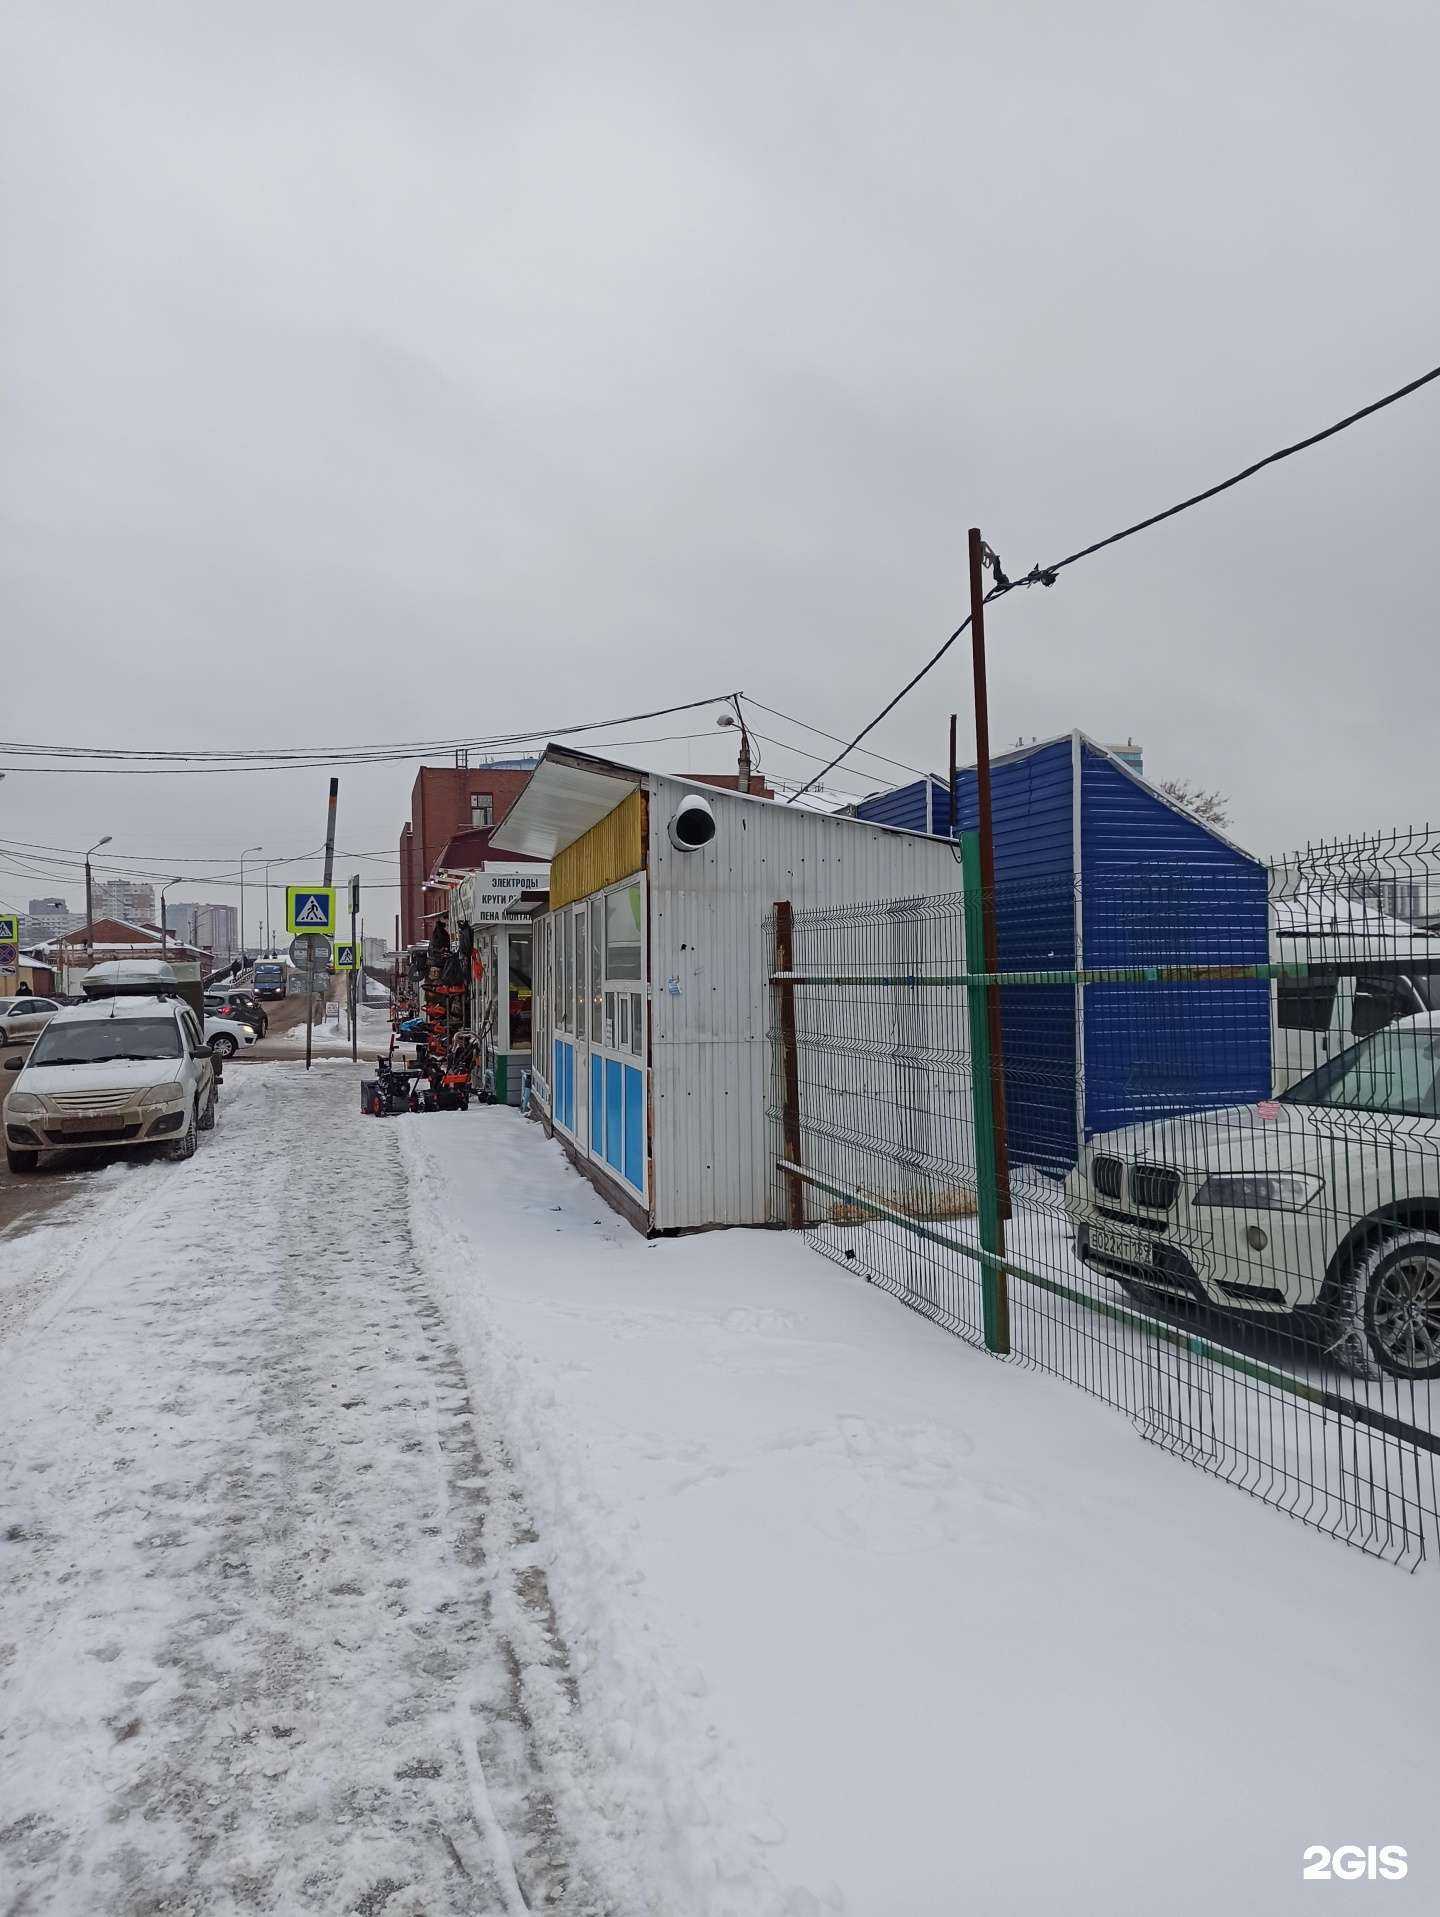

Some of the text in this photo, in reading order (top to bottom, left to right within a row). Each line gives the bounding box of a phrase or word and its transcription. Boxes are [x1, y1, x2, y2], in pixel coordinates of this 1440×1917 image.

[491, 878, 539, 889] ЭЛЕКТРОДЫ
[482, 894, 507, 905] КРУГИ
[480, 911, 500, 921] ПЕНА
